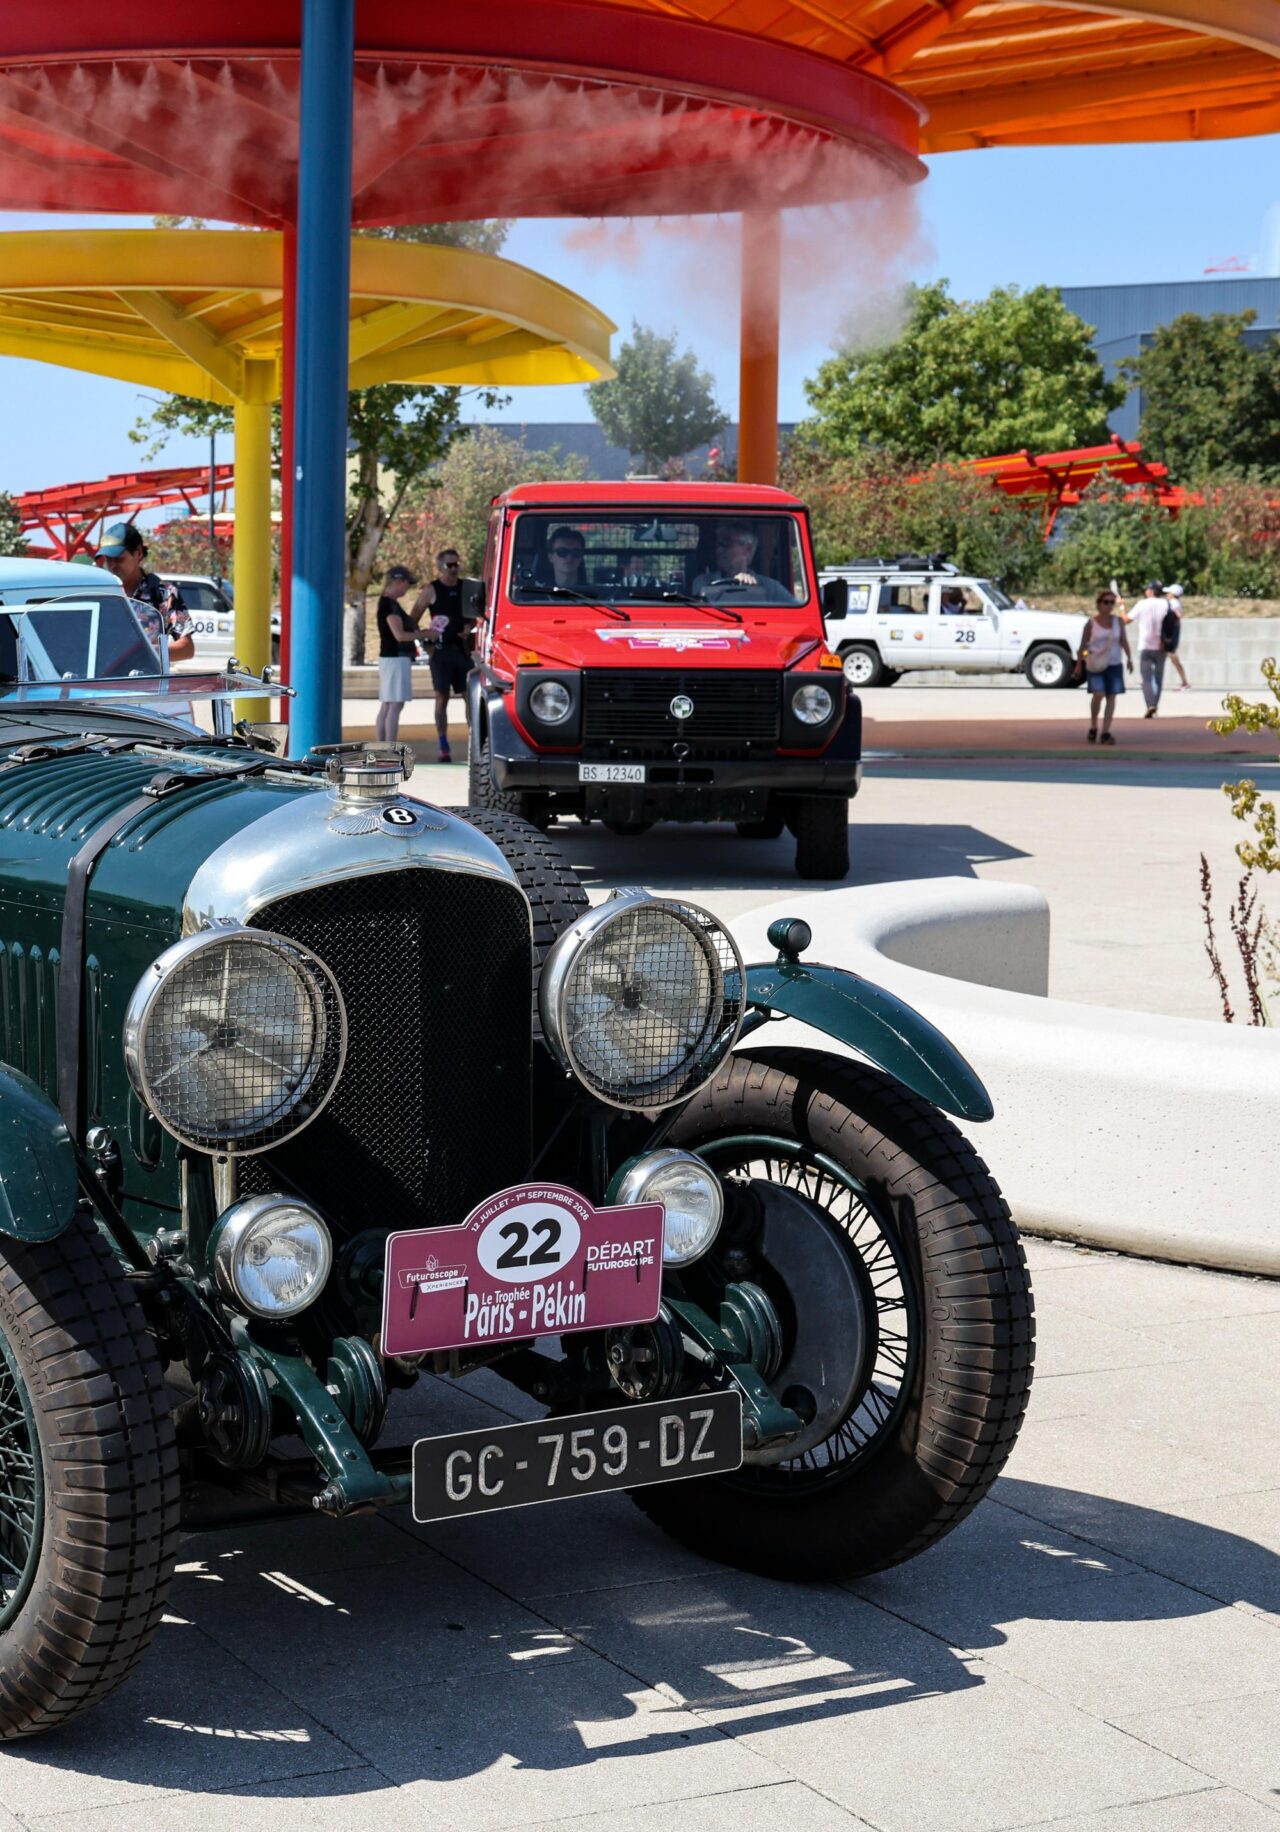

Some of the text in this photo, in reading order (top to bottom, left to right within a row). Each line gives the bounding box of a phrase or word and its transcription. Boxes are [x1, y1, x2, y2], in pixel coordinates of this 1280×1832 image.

[195, 622, 214, 633] 08
[955, 630, 976, 643] 28
[387, 808, 413, 824] B
[471, 1222, 480, 1232] 12
[480, 1198, 510, 1224] JUILLET
[527, 1191, 573, 1206] SEPTEMBRE
[572, 1202, 590, 1221] 2026
[496, 1218, 561, 1270] 22
[587, 1238, 655, 1261] DÉPART
[587, 1256, 654, 1272] FUTUROSCOPE
[482, 1287, 530, 1306] Le Trophée
[464, 1294, 514, 1338] Paris
[531, 1280, 586, 1330] Pékin
[445, 1408, 715, 1501] GC-759-DZ
